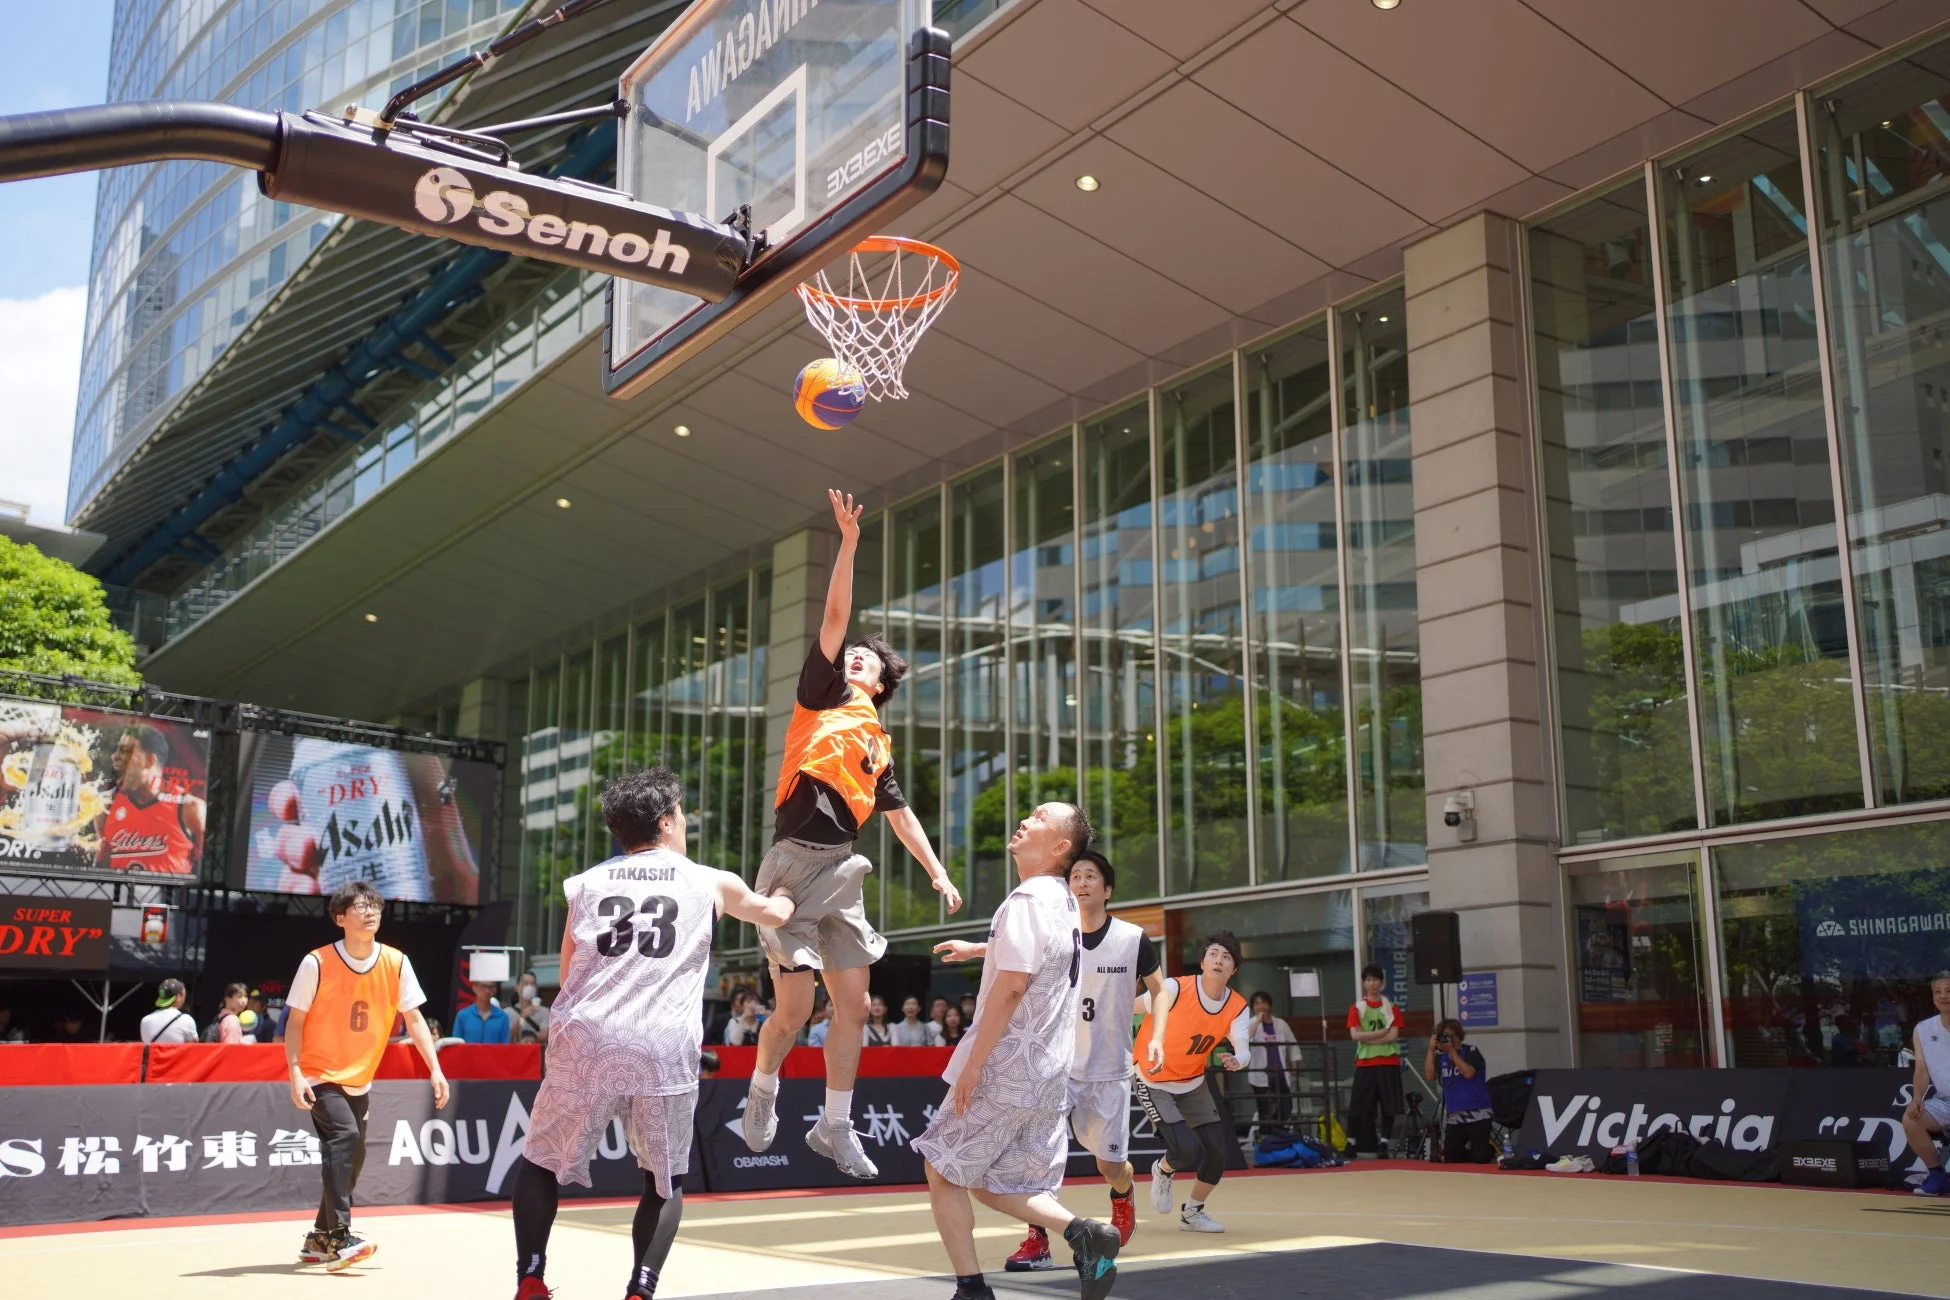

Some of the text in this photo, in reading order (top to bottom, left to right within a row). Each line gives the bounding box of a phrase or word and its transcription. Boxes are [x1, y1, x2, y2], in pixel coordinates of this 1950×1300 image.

[477, 190, 691, 275] Senoh
[318, 799, 414, 866] Asahi
[361, 862, 387, 881] 生
[607, 867, 676, 882] TAKASHI
[13, 907, 73, 923] SUPER
[596, 894, 679, 959] 33
[1097, 966, 1128, 974] ALL BLACKS
[350, 1000, 369, 1033] 6
[1082, 998, 1096, 1022] 3
[1186, 1033, 1216, 1056] 10
[1537, 1094, 1775, 1152] Victoria
[733, 1155, 790, 1169] OBAYASHI
